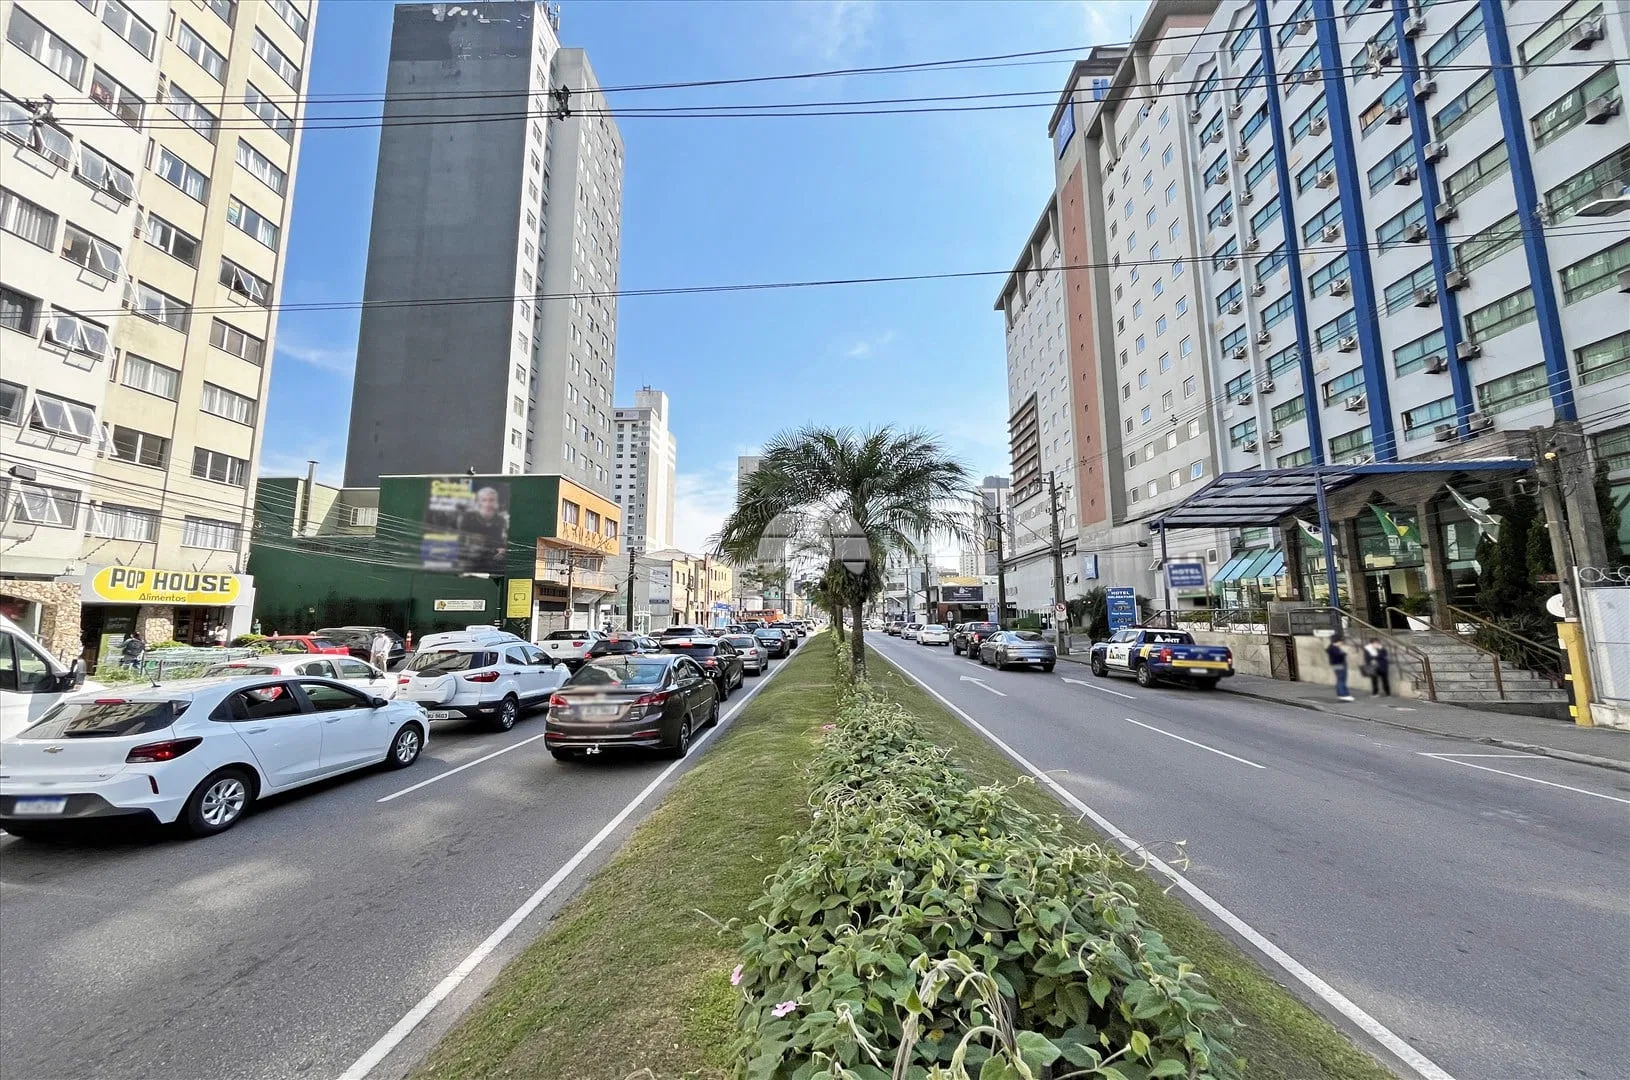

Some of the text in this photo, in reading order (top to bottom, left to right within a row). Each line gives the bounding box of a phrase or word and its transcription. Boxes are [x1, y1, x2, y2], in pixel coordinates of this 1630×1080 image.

[110, 568, 232, 592] POP HOUSE
[138, 592, 186, 602] Alimentos
